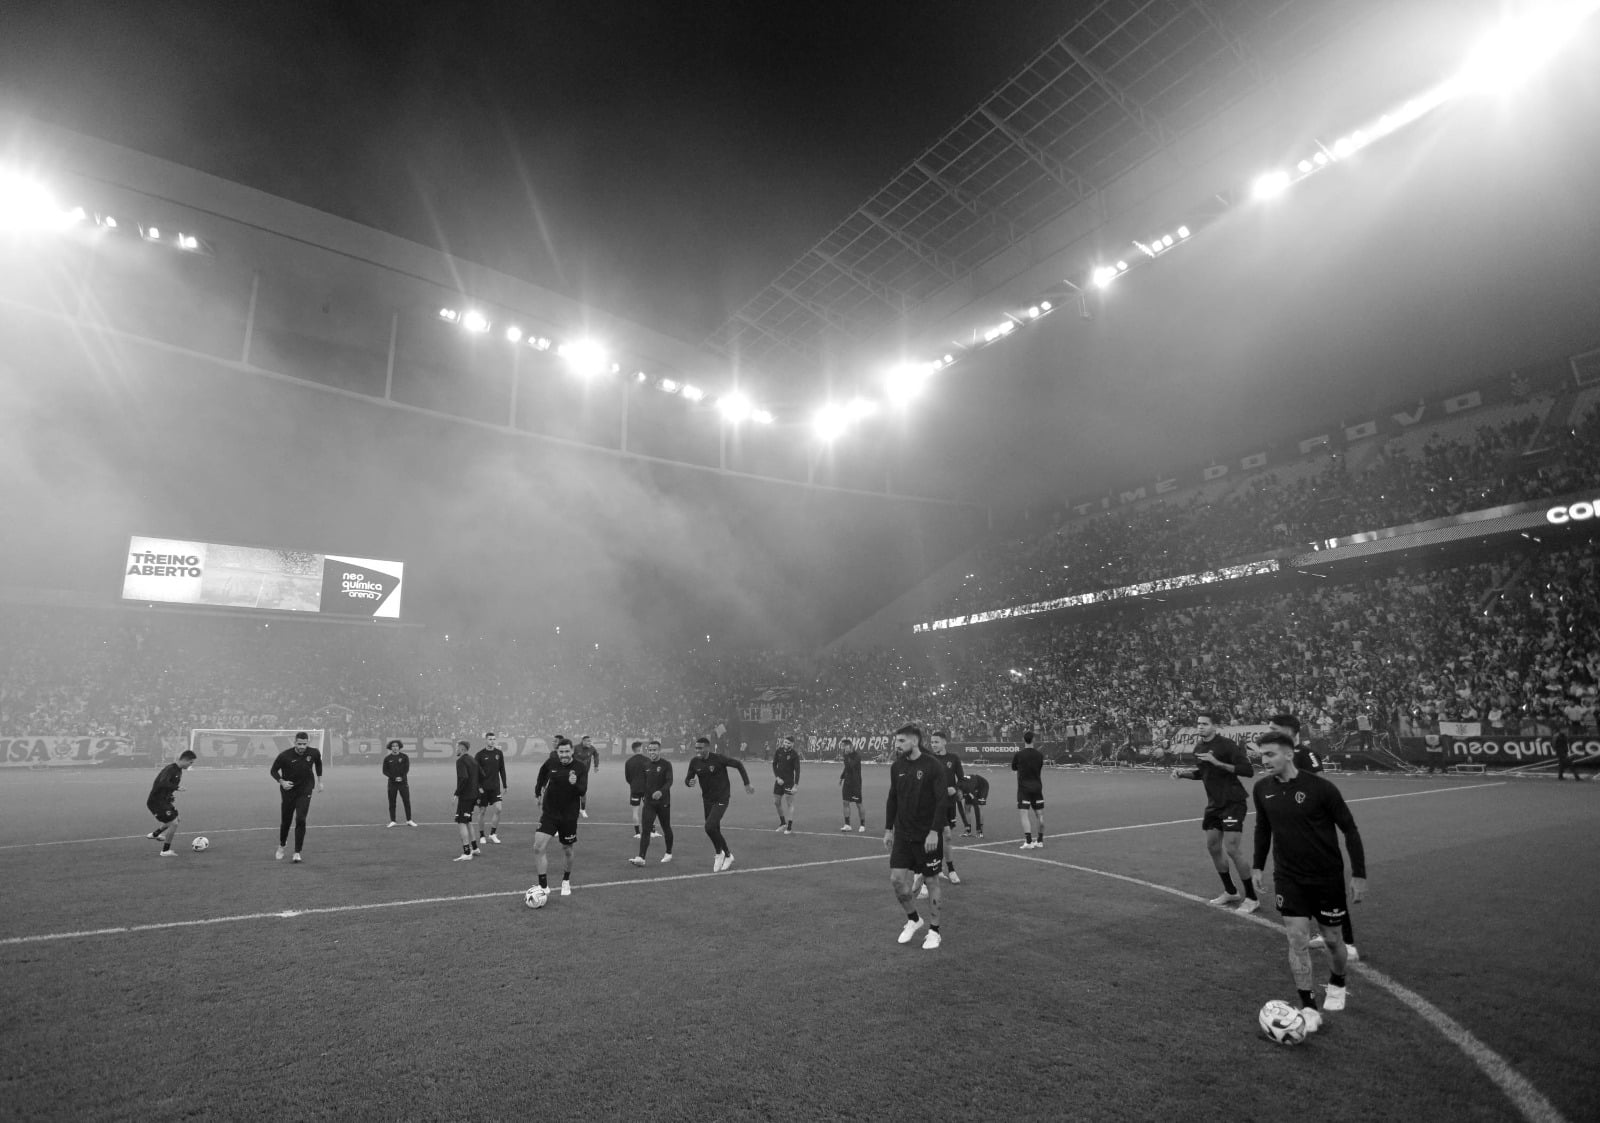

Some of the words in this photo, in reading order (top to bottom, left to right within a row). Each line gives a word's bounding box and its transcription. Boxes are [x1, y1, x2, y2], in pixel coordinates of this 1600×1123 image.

[131, 551, 199, 566] TREINO
[127, 565, 201, 578] ABERTO
[342, 572, 364, 581] neo
[348, 591, 375, 599] arena
[72, 738, 119, 761] 12
[868, 736, 889, 751] FOR
[1453, 741, 1499, 755] neo
